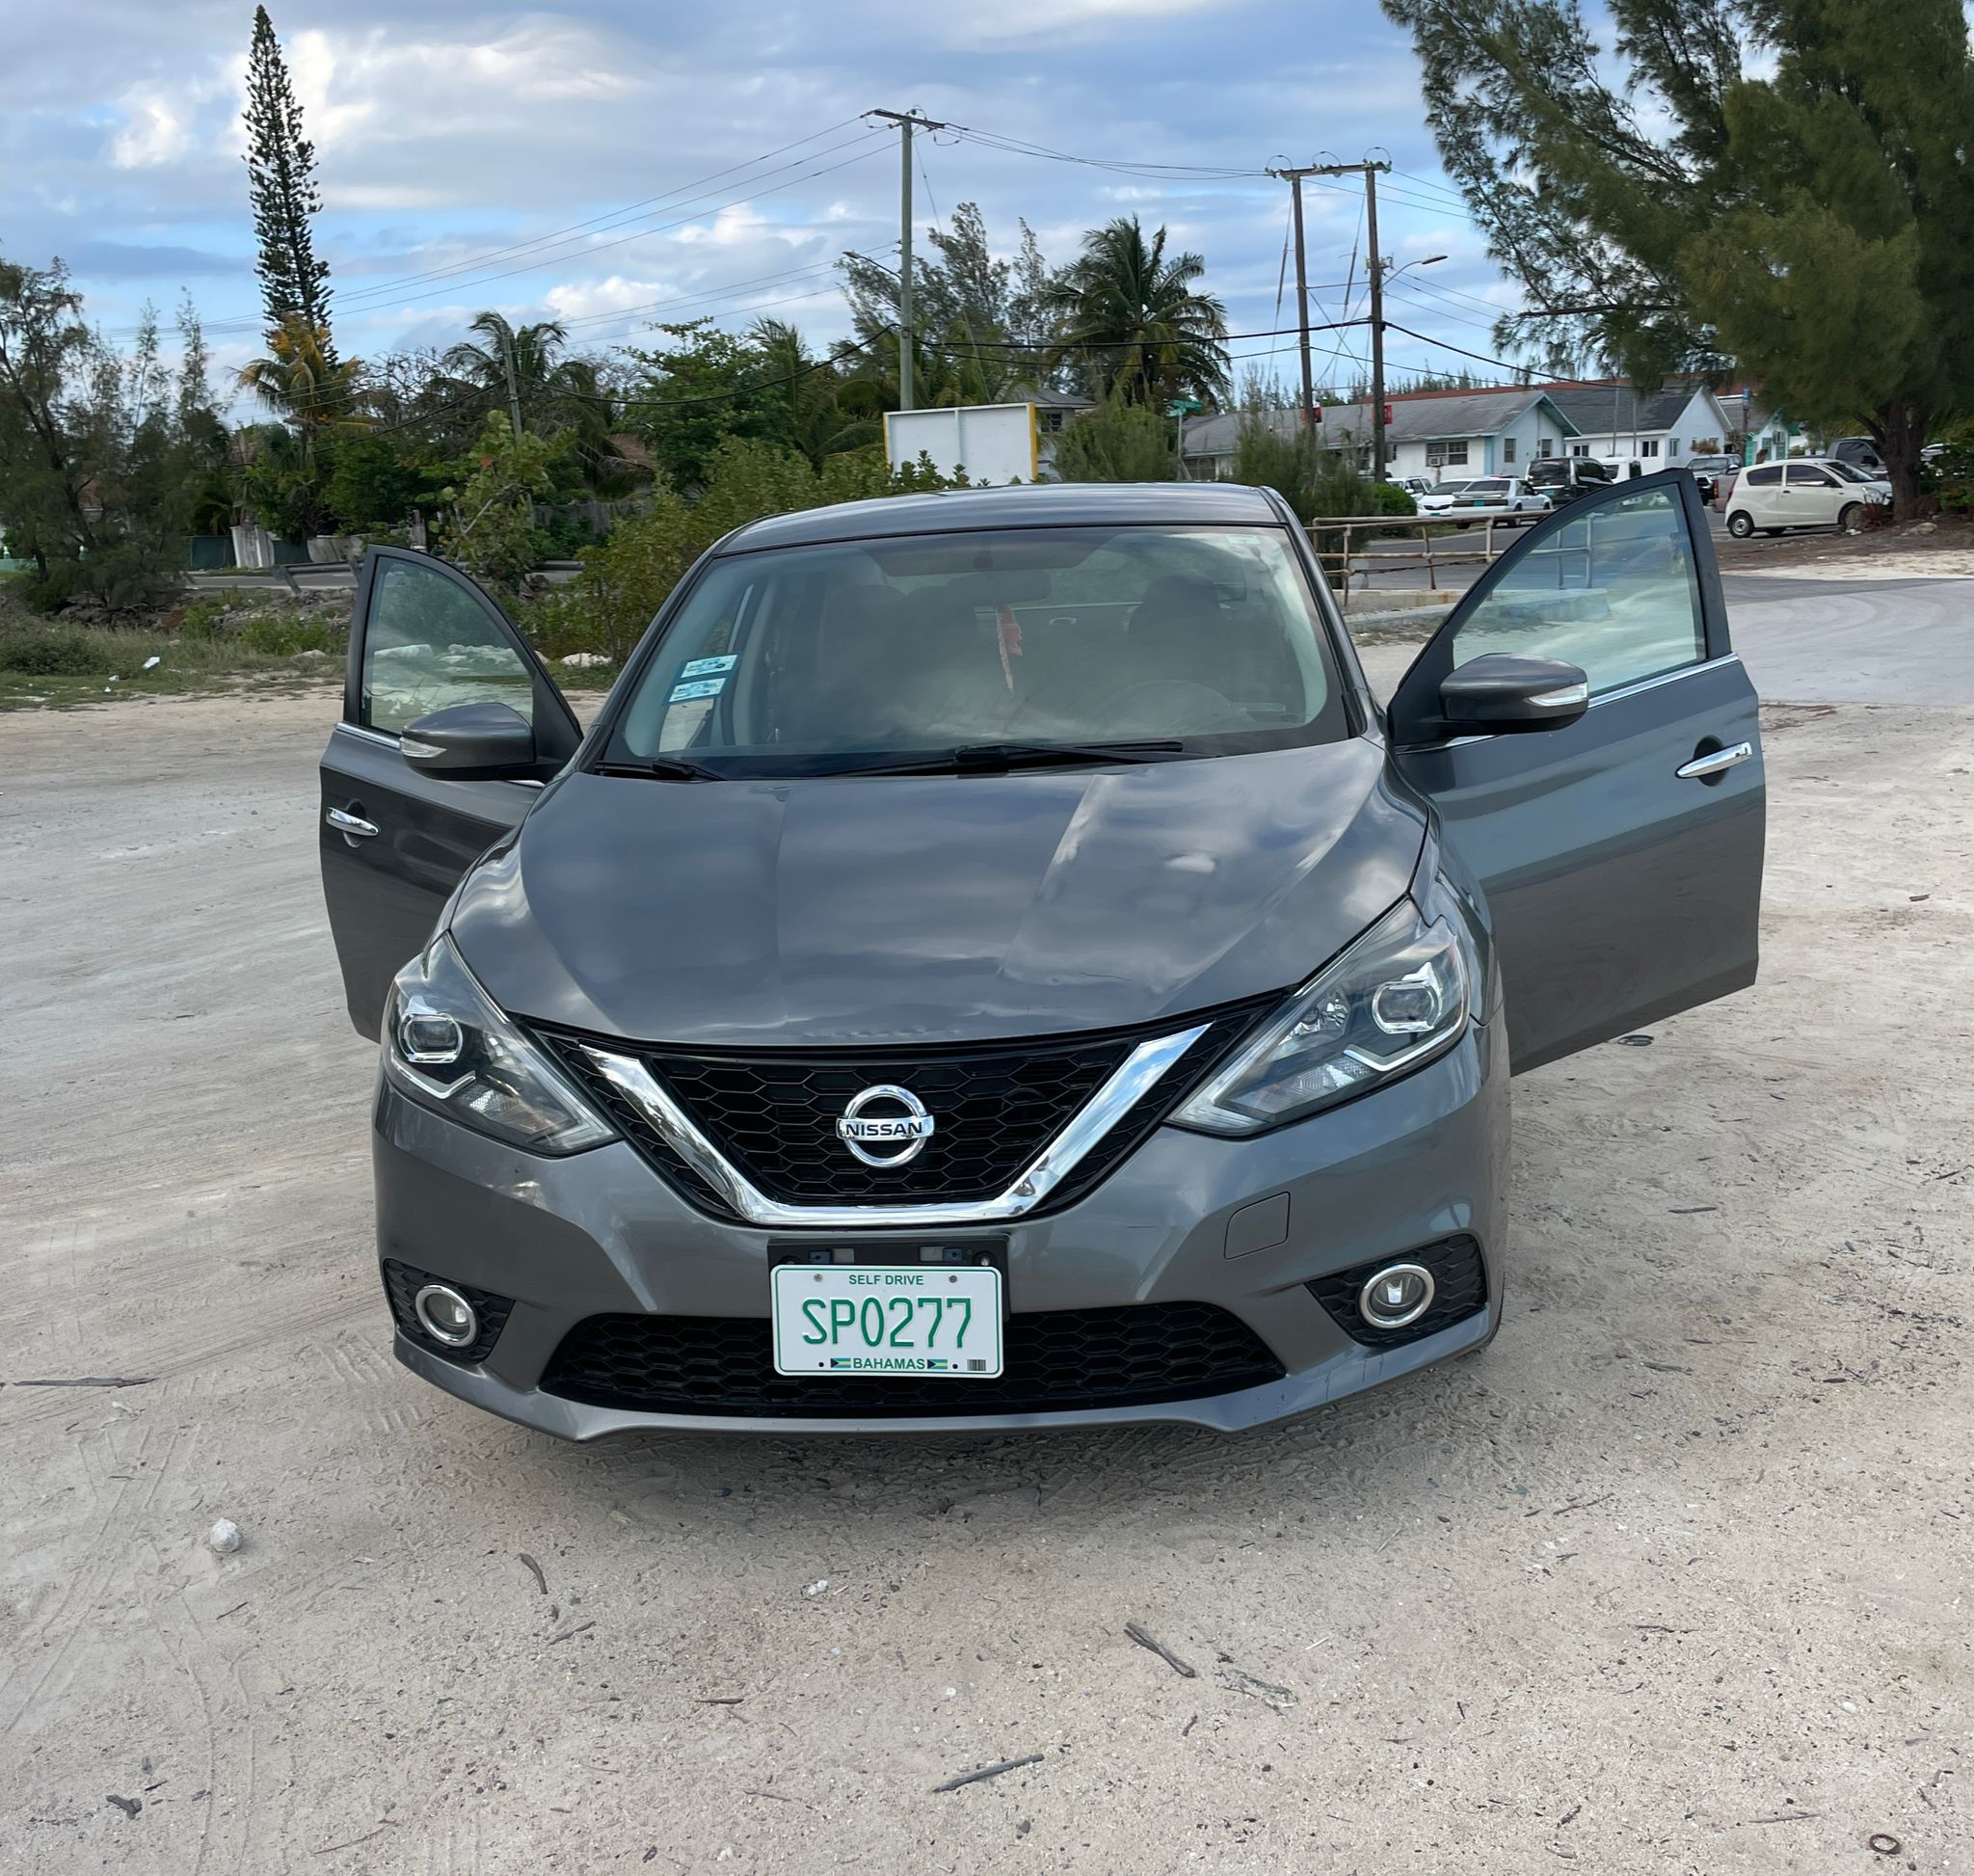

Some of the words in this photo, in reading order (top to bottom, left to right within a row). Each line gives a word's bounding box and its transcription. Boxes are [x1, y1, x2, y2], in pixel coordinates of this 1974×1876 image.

[845, 1121, 922, 1136] NISSAN
[848, 1274, 881, 1285] SELF
[885, 1274, 924, 1286] DRIVE
[802, 1297, 972, 1349] SP0277
[853, 1357, 925, 1370] BAHAMAS
